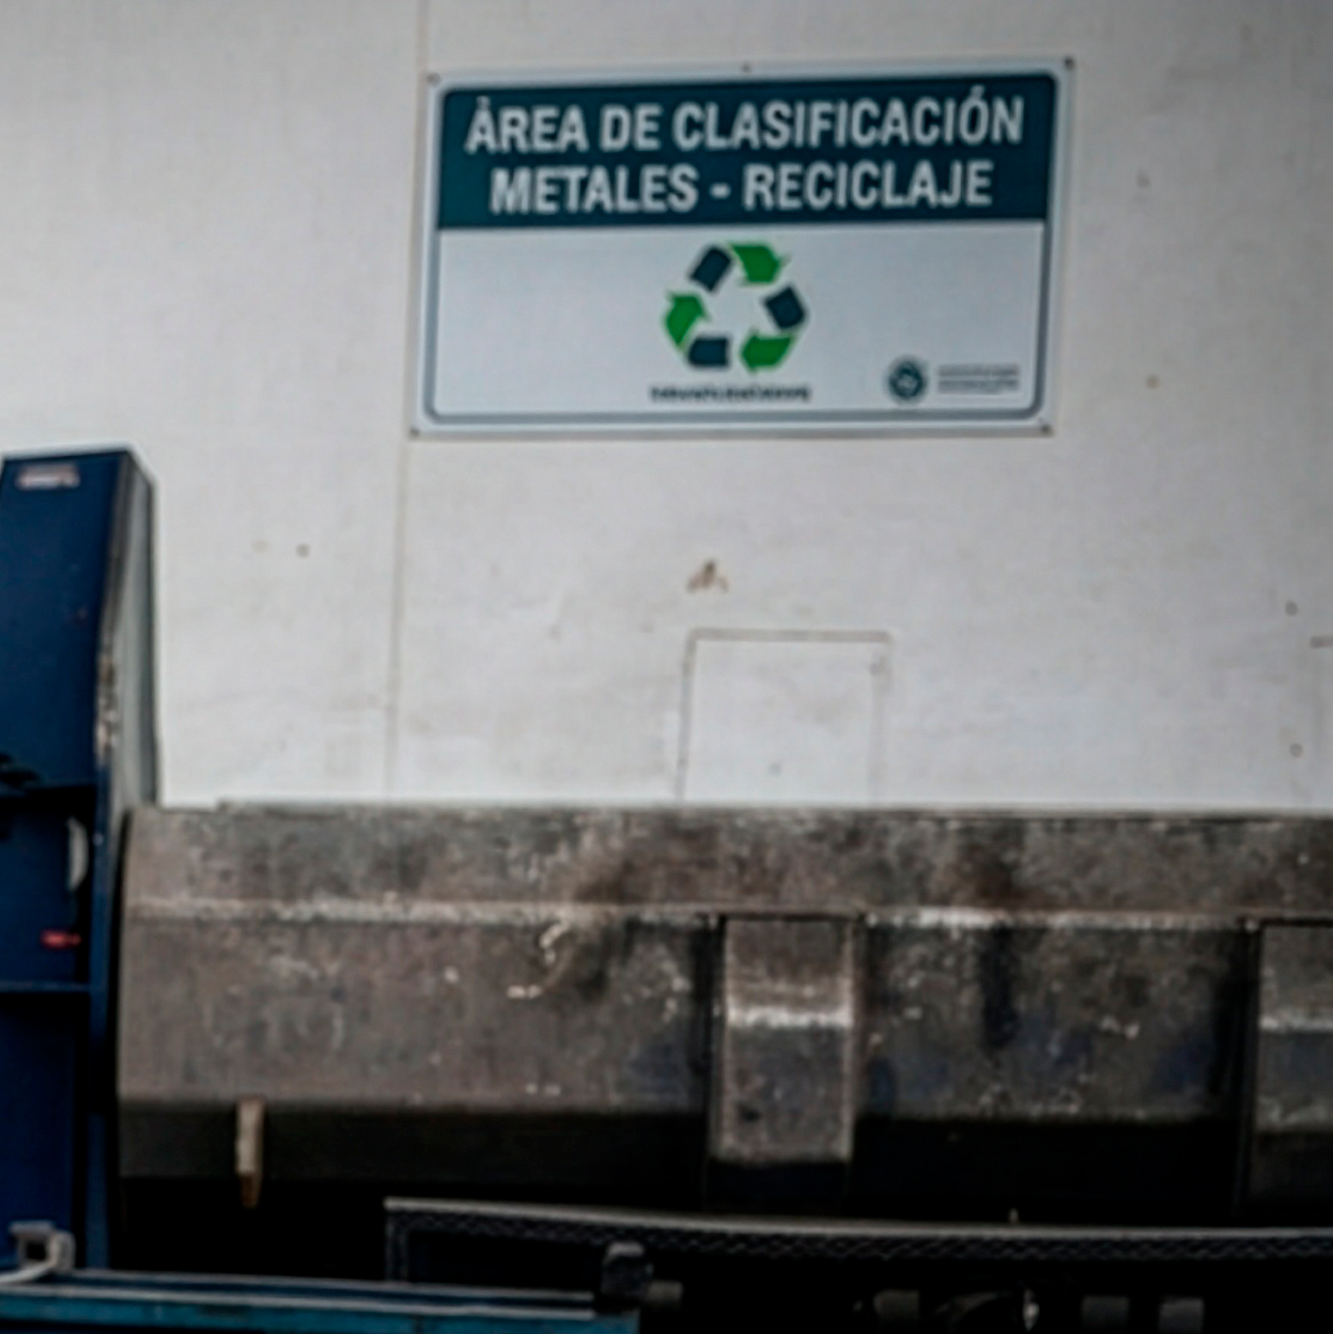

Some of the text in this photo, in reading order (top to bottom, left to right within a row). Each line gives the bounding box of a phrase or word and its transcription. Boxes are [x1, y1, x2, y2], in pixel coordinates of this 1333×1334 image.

[464, 85, 1024, 155] ÁREA DE CLASIFICACIÓN
[489, 159, 993, 215] METALES - RECICLAJE
